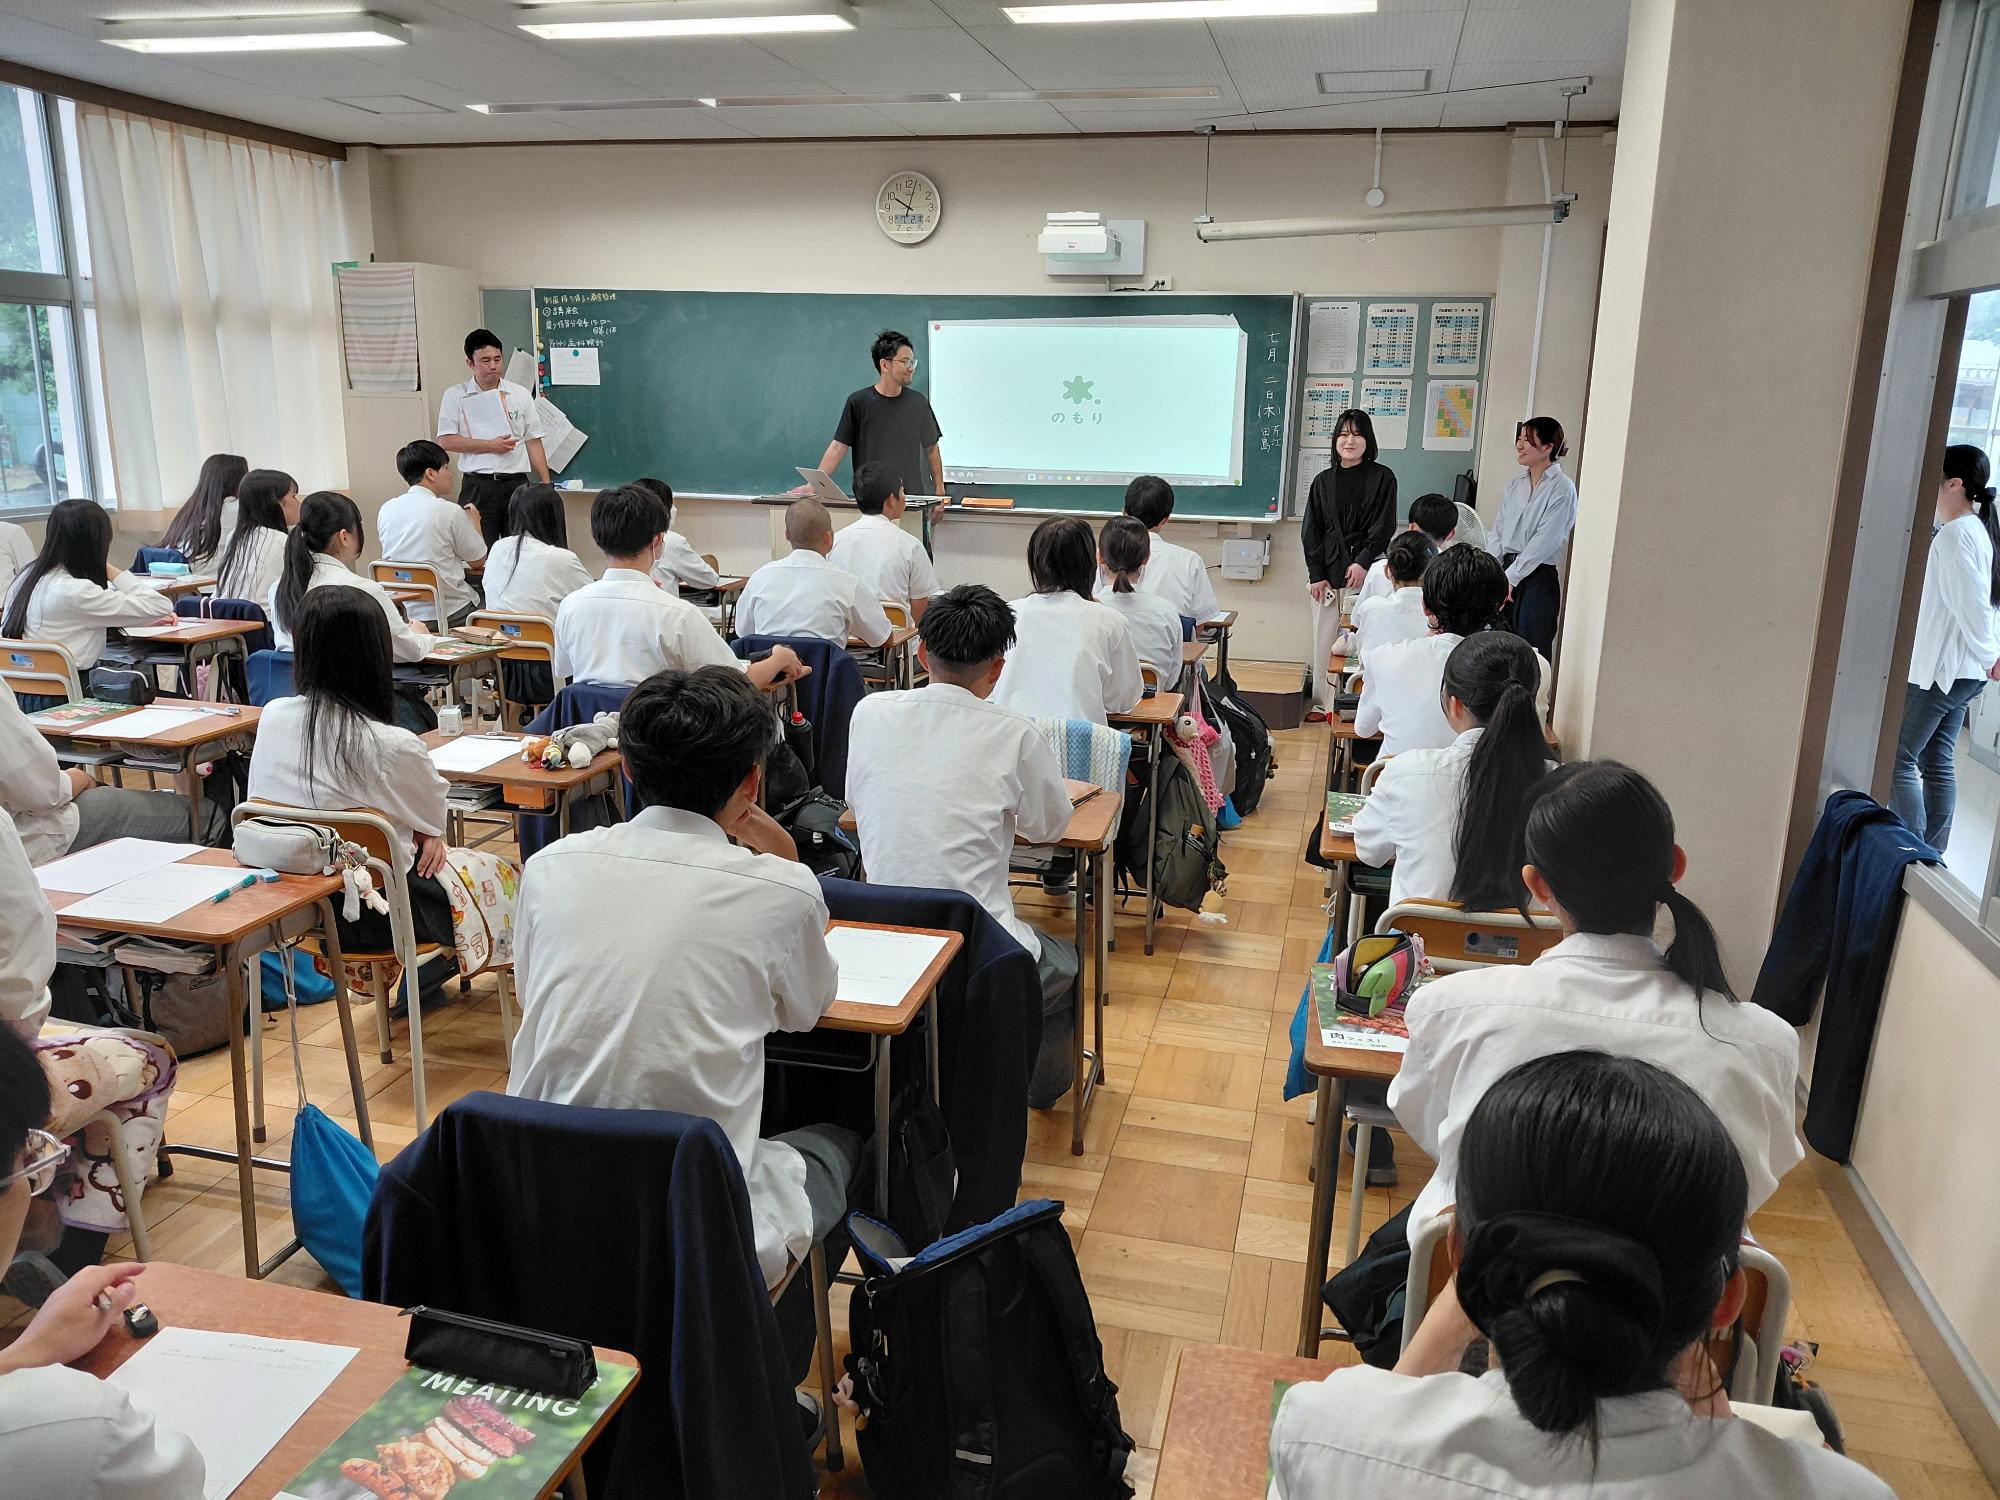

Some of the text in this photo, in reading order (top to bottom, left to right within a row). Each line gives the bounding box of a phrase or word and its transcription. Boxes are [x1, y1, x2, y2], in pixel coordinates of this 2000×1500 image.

[905, 179, 914, 189] 12
[887, 192, 895, 200] 10
[925, 191, 931, 201] 2
[884, 204, 891, 212] 9
[928, 204, 934, 212] 3
[888, 216, 894, 224] 8
[925, 216, 931, 224] 4
[1051, 411, 1103, 425] のもり
[421, 1370, 579, 1417] MEATING
